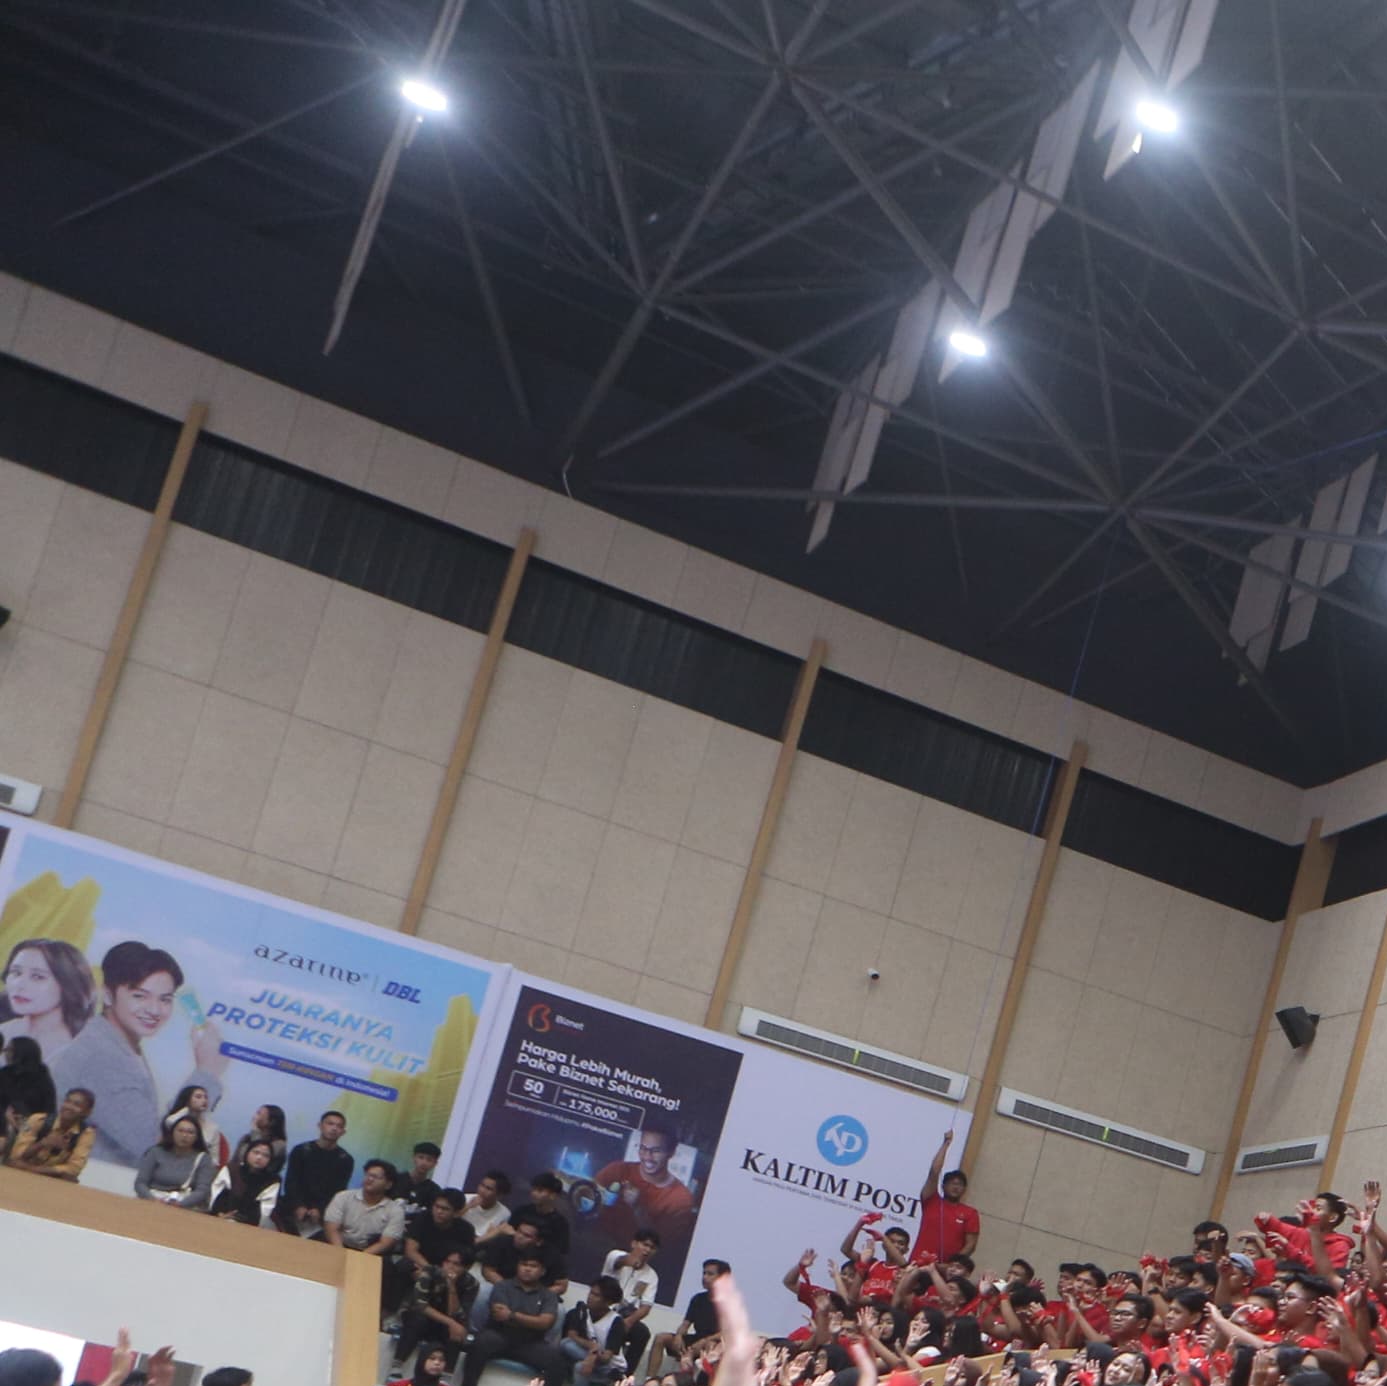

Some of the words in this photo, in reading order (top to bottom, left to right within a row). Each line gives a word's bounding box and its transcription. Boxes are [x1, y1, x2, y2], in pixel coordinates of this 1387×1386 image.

[250, 989, 394, 1041] JUARANYA
[382, 981, 421, 1004] DBL
[206, 1001, 344, 1051] PROTEKSI
[345, 1040, 425, 1075] KULIT
[517, 1052, 557, 1074] Pake
[559, 1066, 605, 1088] Biznet
[607, 1080, 681, 1111] Sekarang!
[520, 1040, 567, 1063] Harga
[570, 1055, 611, 1078] Lebih
[613, 1068, 662, 1093] Murah,
[523, 1079, 545, 1094] 50
[740, 1149, 850, 1200] KALTIM
[852, 1181, 922, 1219] POST
